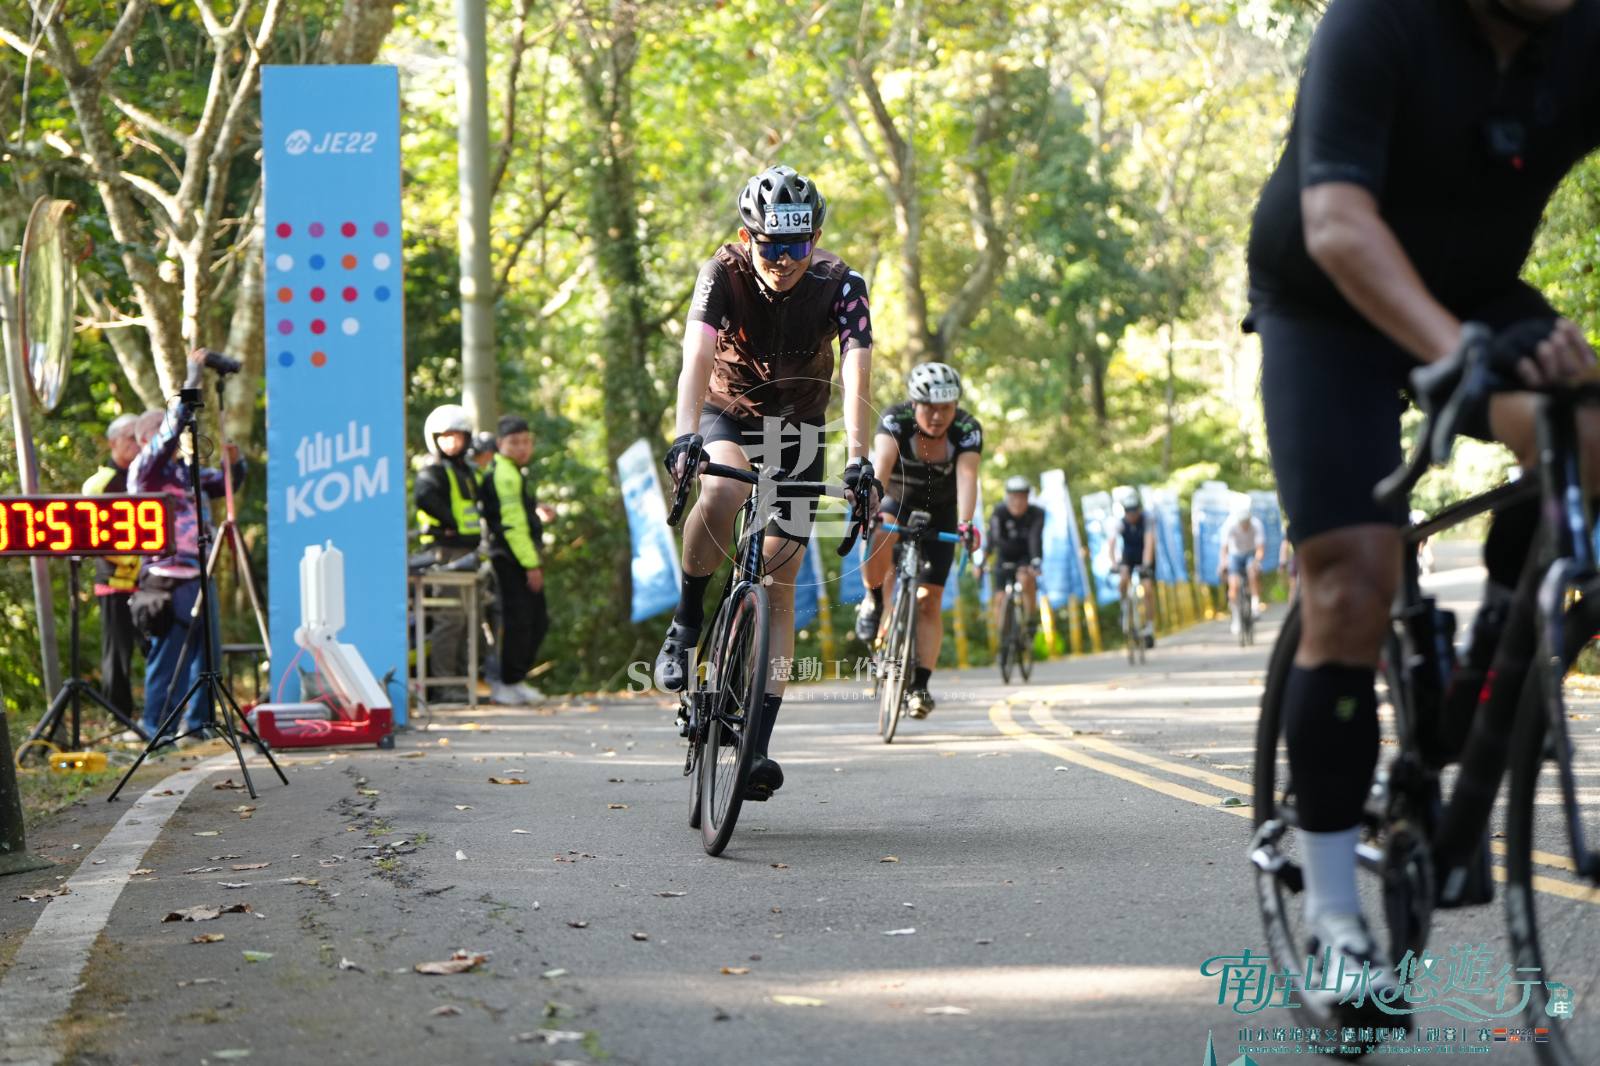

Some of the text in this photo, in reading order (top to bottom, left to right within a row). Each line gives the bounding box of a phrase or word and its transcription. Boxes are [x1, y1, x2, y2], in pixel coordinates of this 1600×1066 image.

[313, 132, 378, 153] JE22
[295, 420, 370, 477] 仙山
[286, 455, 390, 524] KOM
